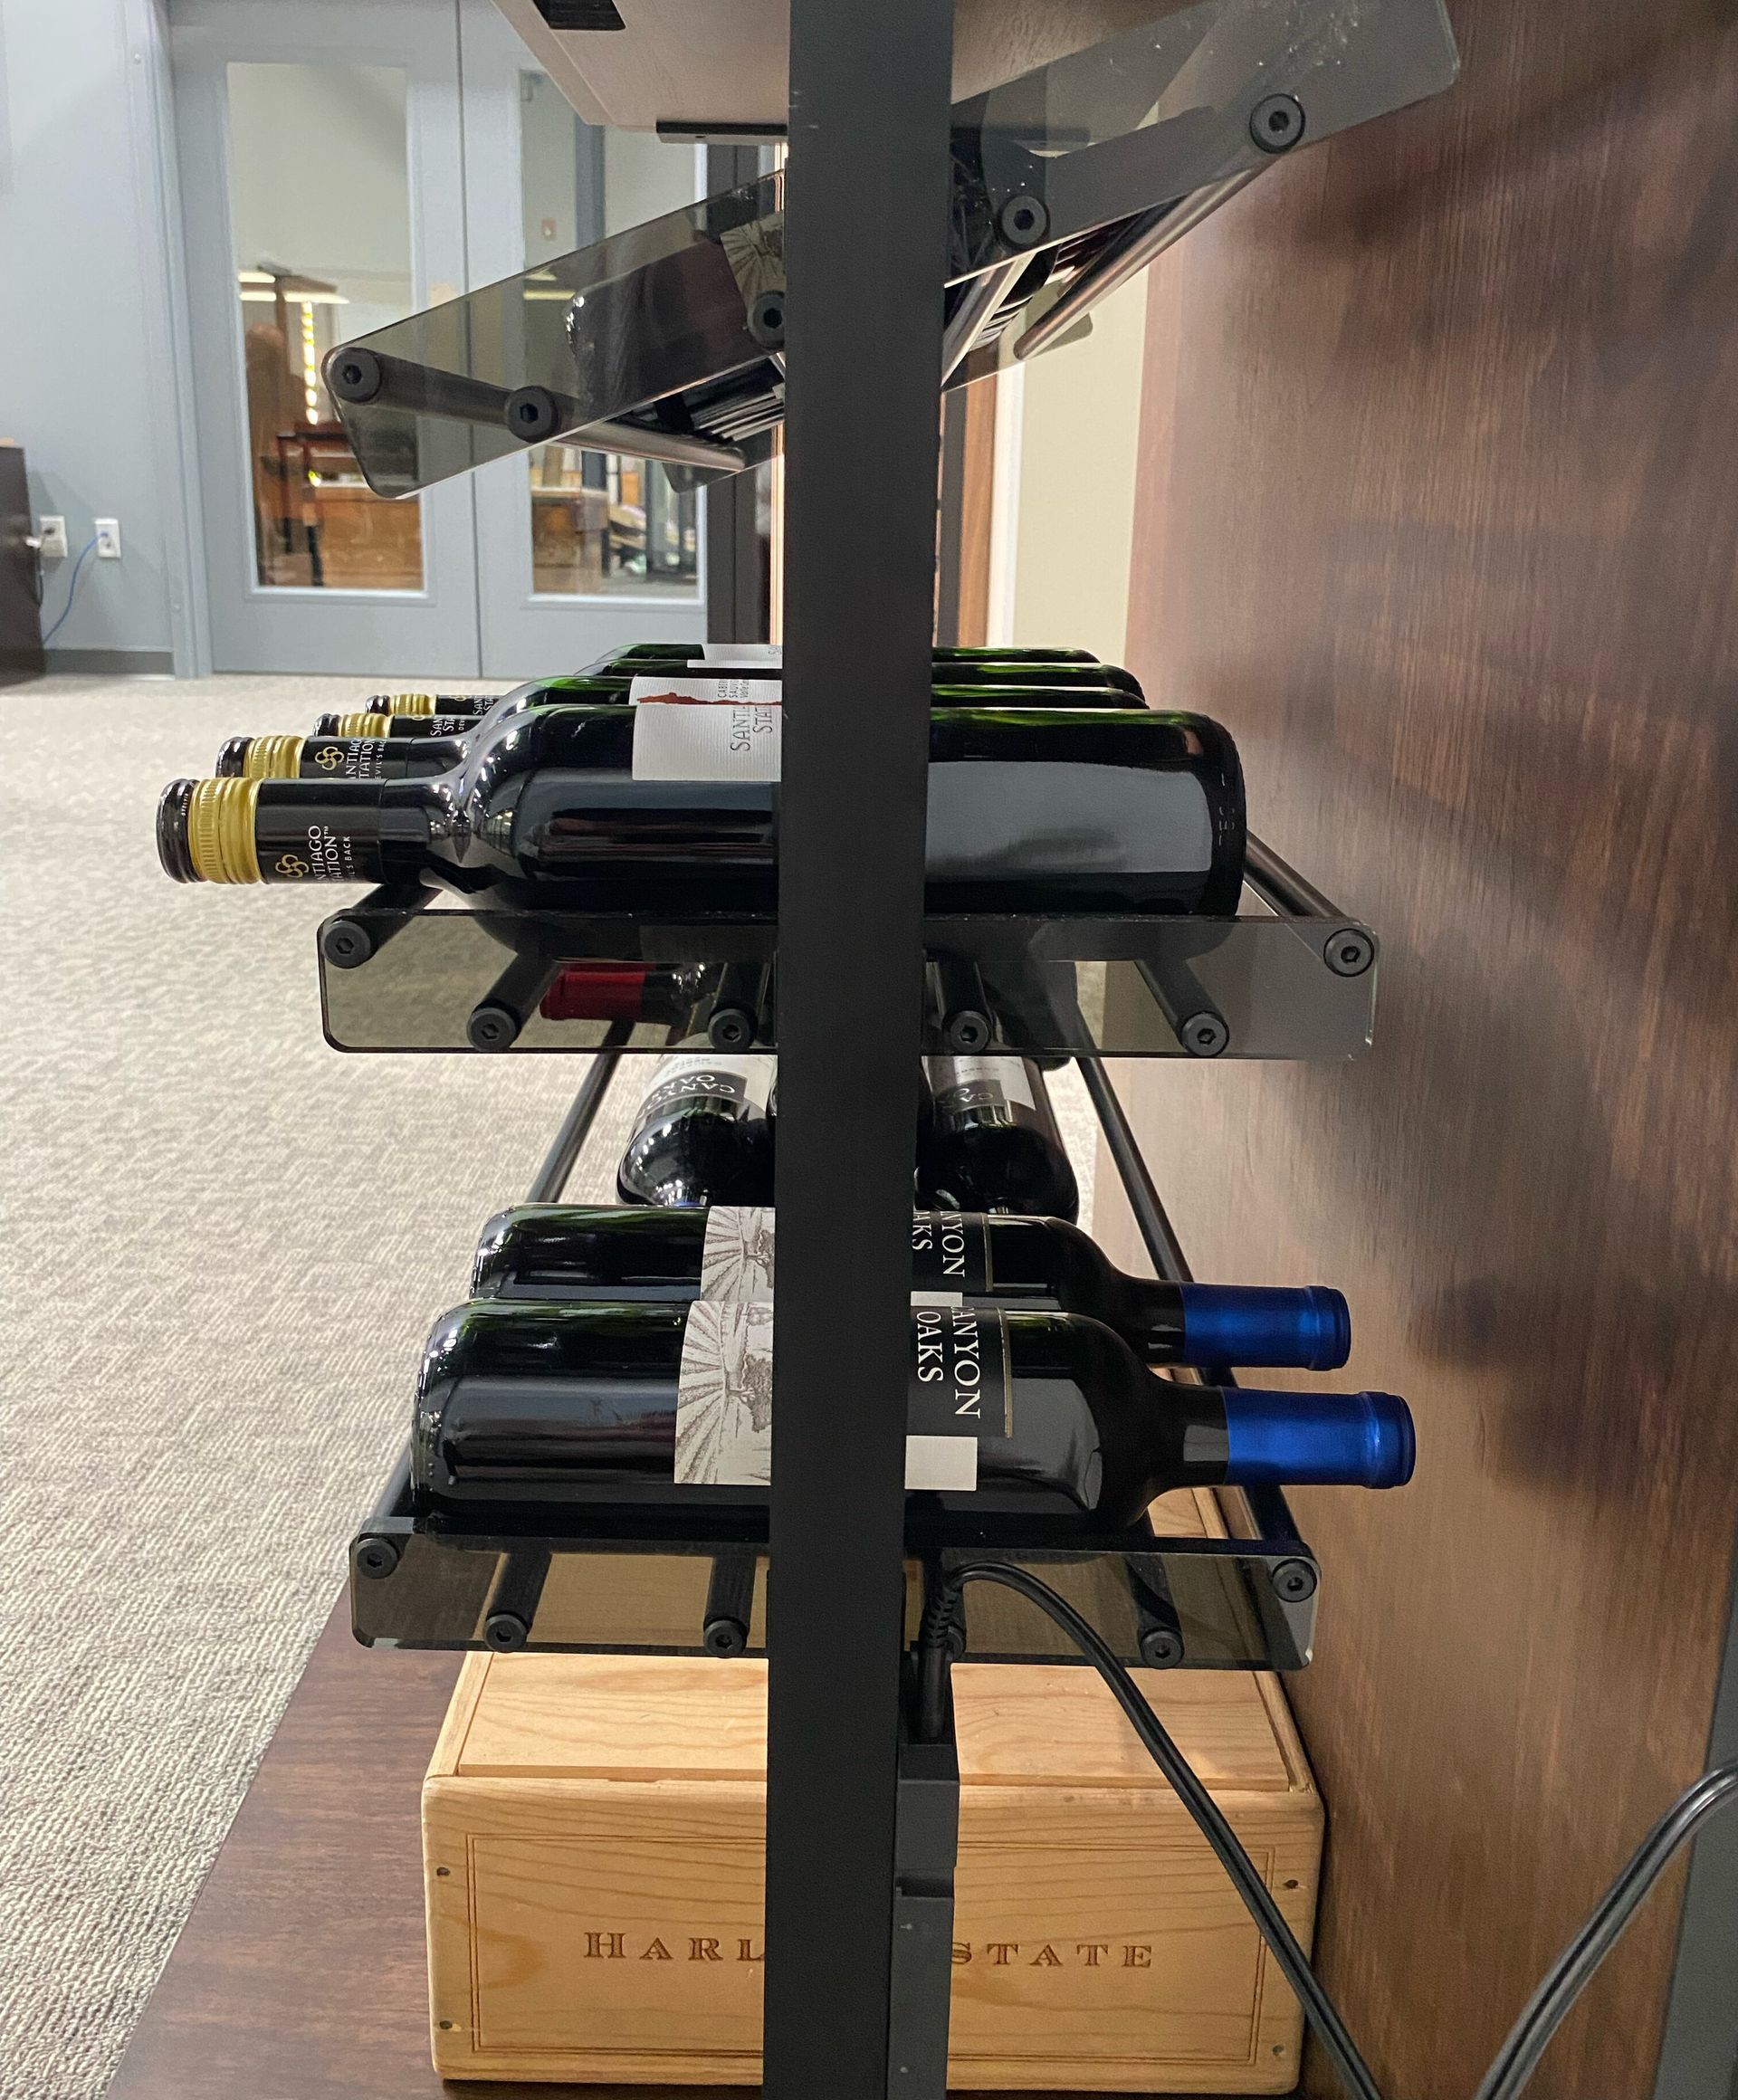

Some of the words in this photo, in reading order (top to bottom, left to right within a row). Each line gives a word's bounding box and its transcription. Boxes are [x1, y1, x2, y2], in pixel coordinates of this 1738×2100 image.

[309, 826, 326, 881] NTIAGO
[343, 836, 352, 861] BACK
[916, 1311, 944, 1382] OAKS
